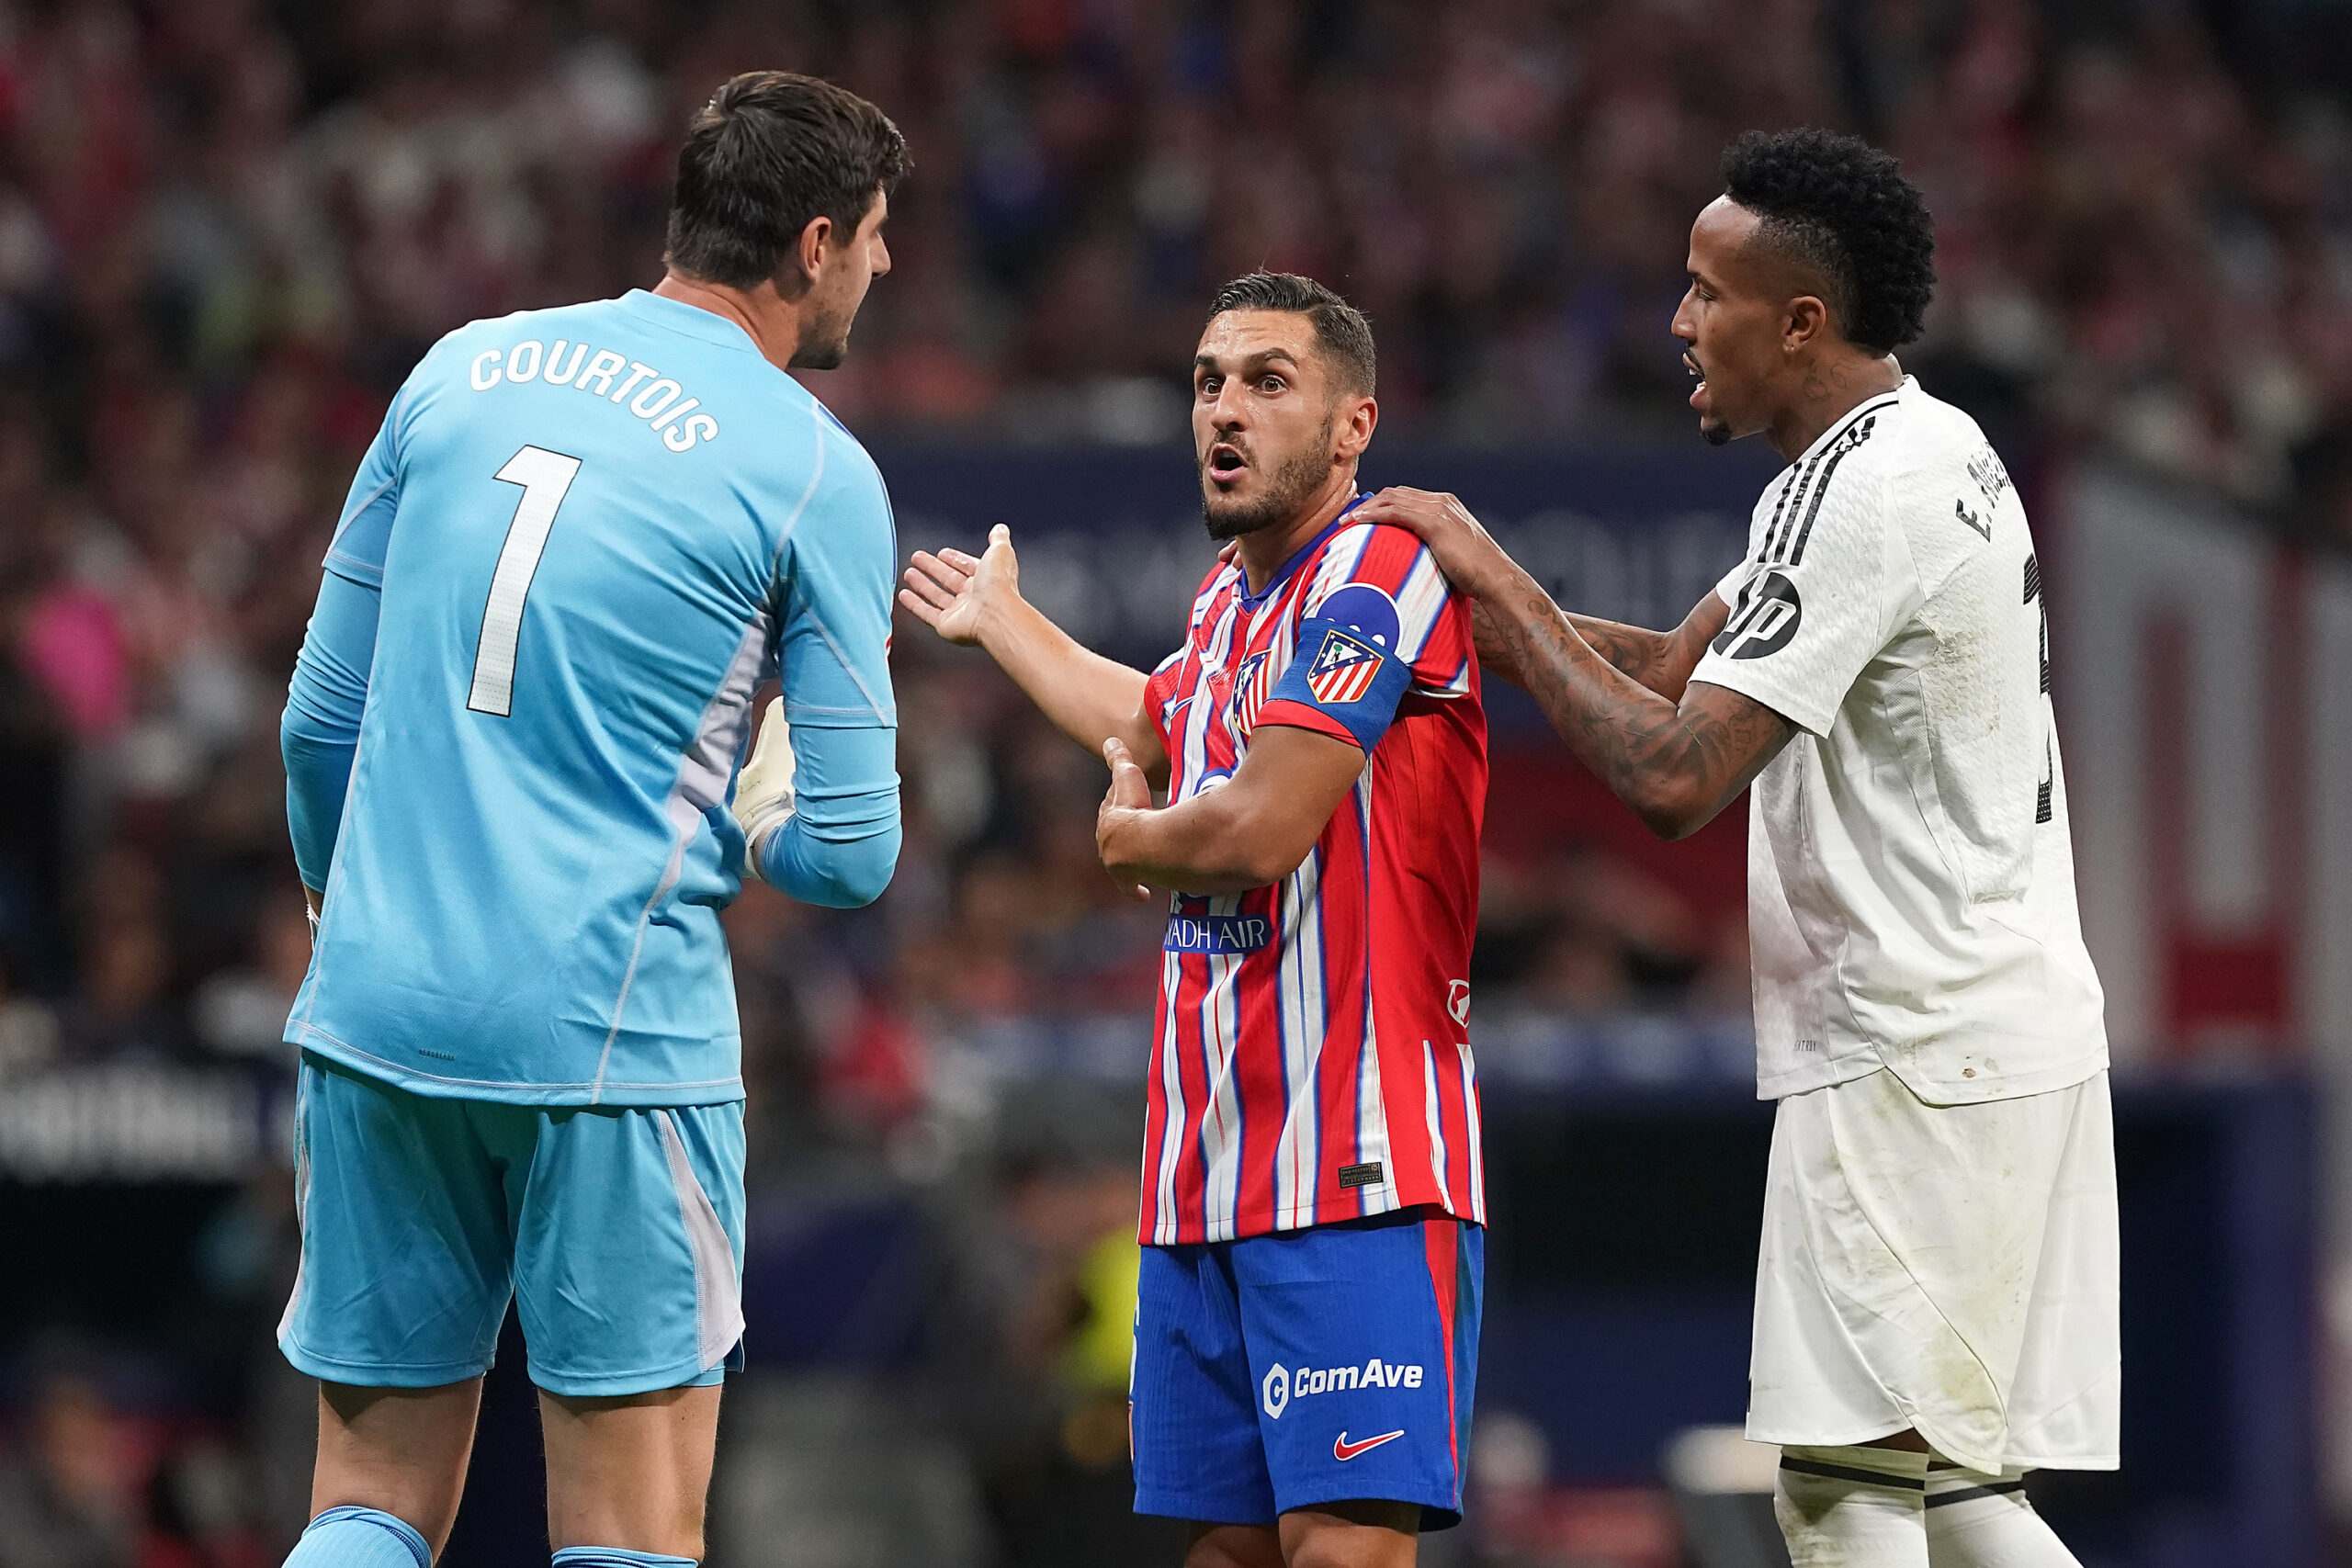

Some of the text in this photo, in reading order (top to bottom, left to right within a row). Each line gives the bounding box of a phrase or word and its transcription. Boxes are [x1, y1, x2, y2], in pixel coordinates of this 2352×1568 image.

[470, 340, 719, 452] COURTOIS
[466, 445, 582, 718] 1
[1217, 919, 1265, 949] AIR
[1294, 1358, 1424, 1398] ComAve
